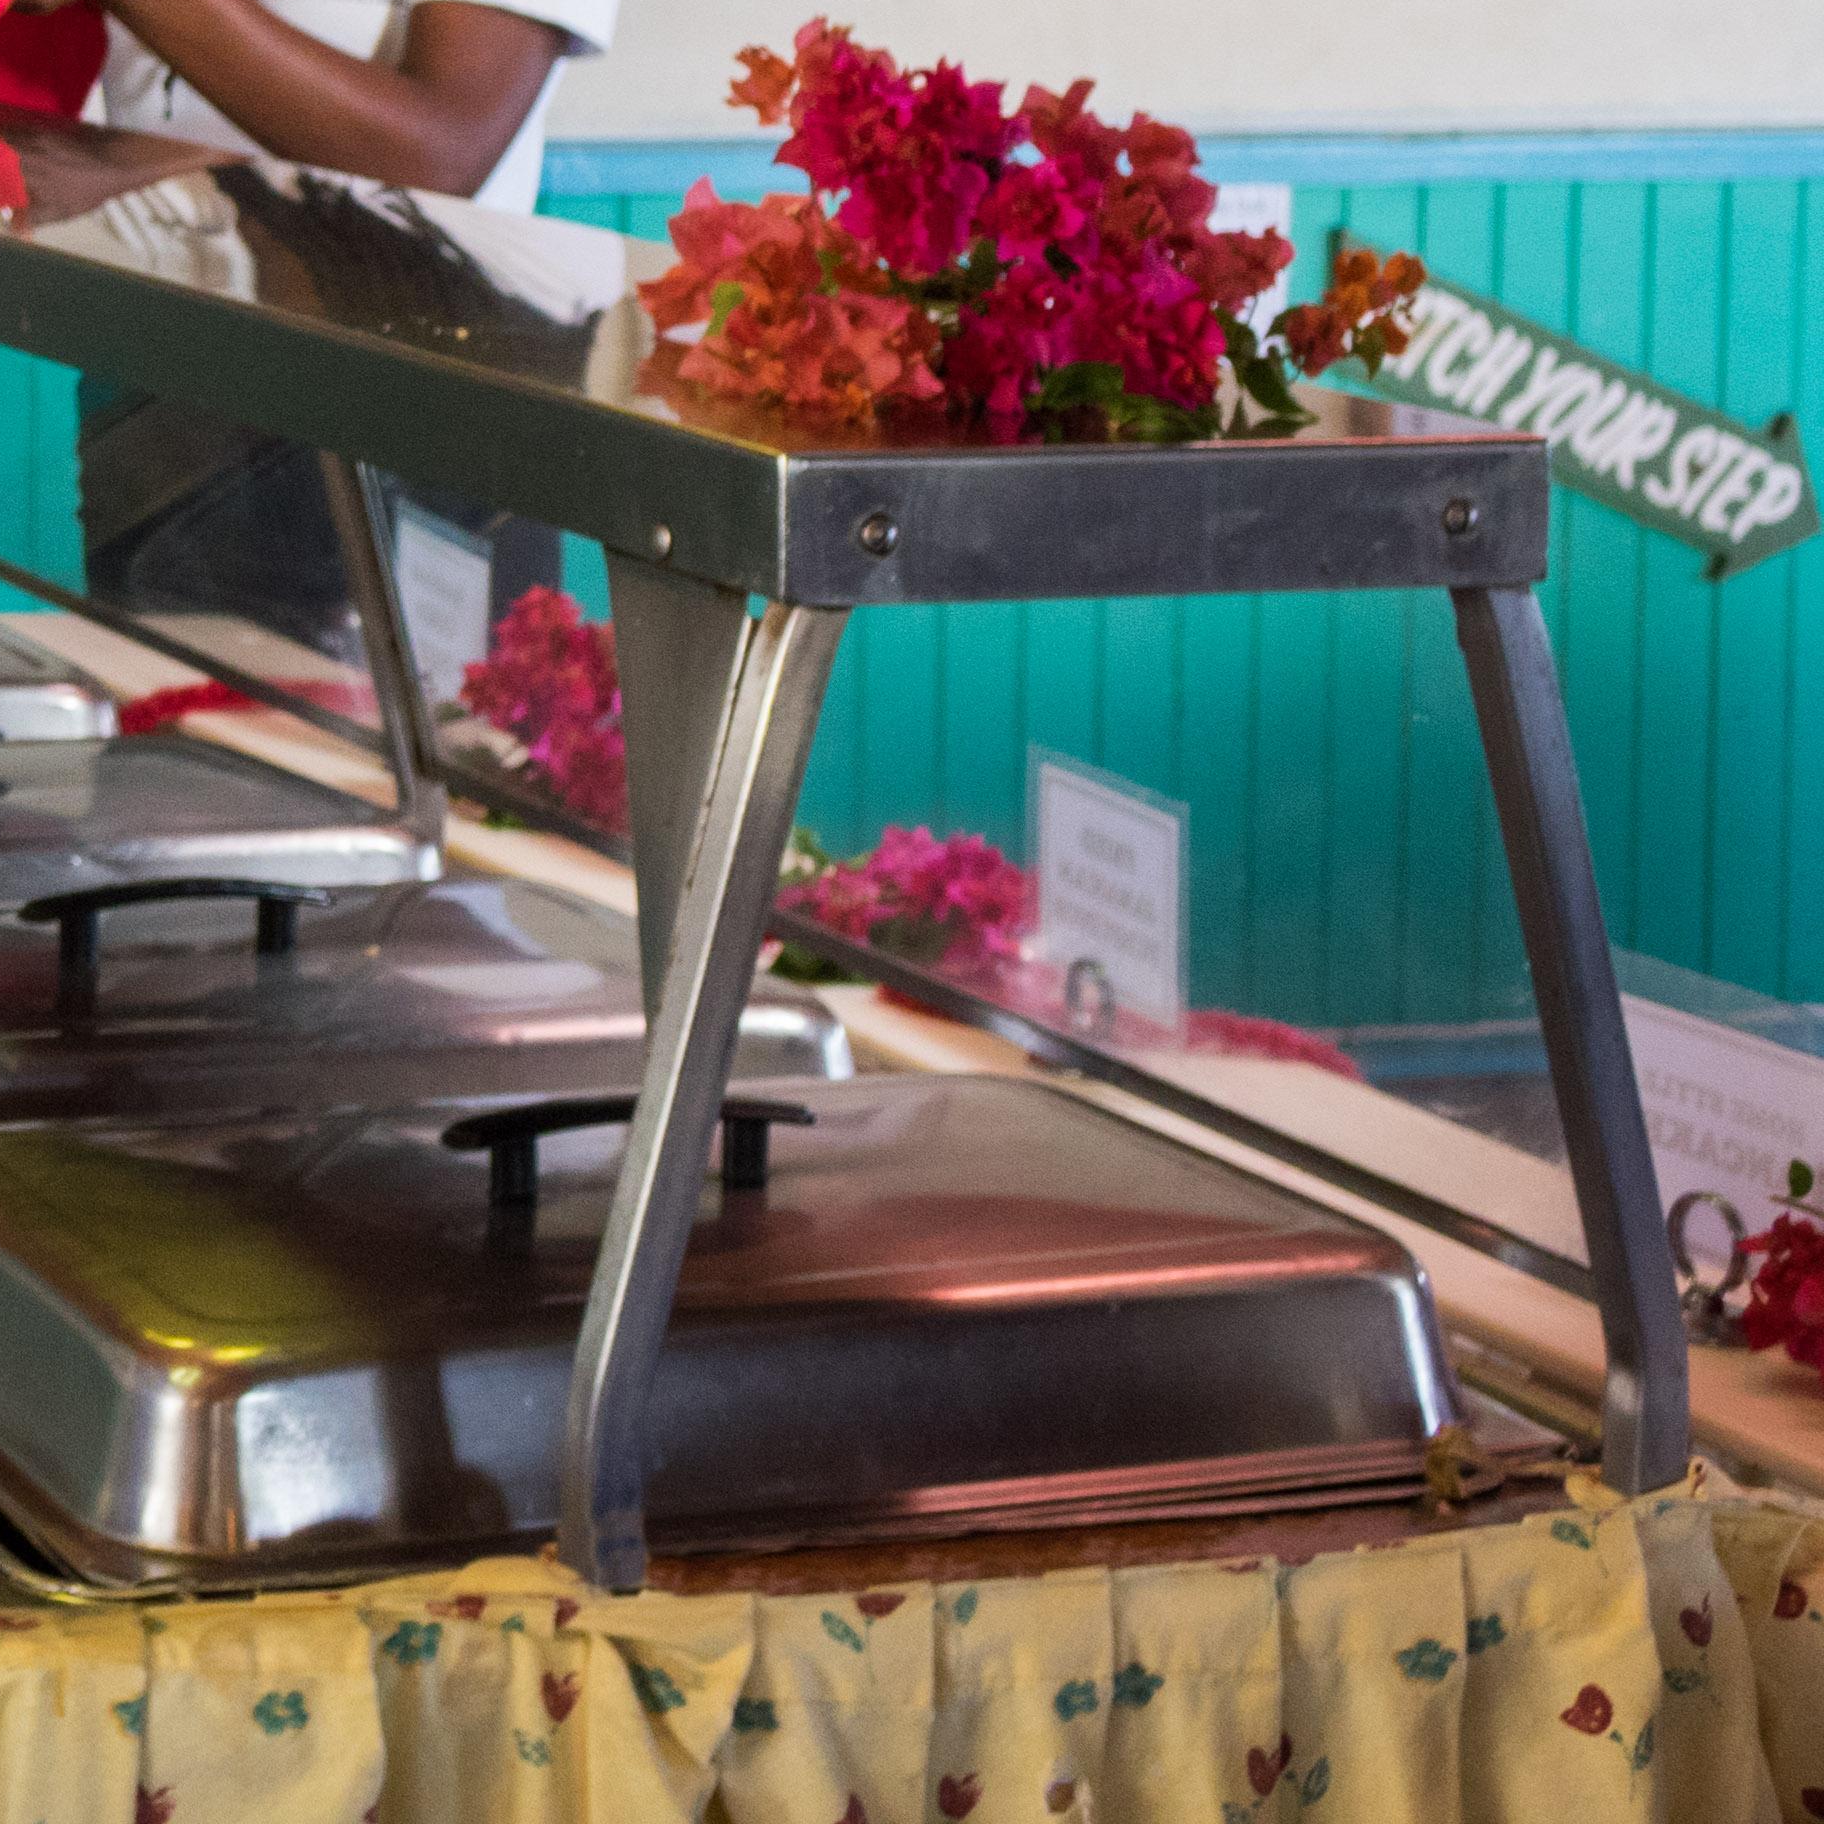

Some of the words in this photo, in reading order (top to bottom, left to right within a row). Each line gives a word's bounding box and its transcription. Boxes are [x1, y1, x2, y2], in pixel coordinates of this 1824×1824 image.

[1384, 287, 1534, 416] TCH
[1499, 346, 1679, 490] YOUR
[1642, 423, 1803, 544] STEP
